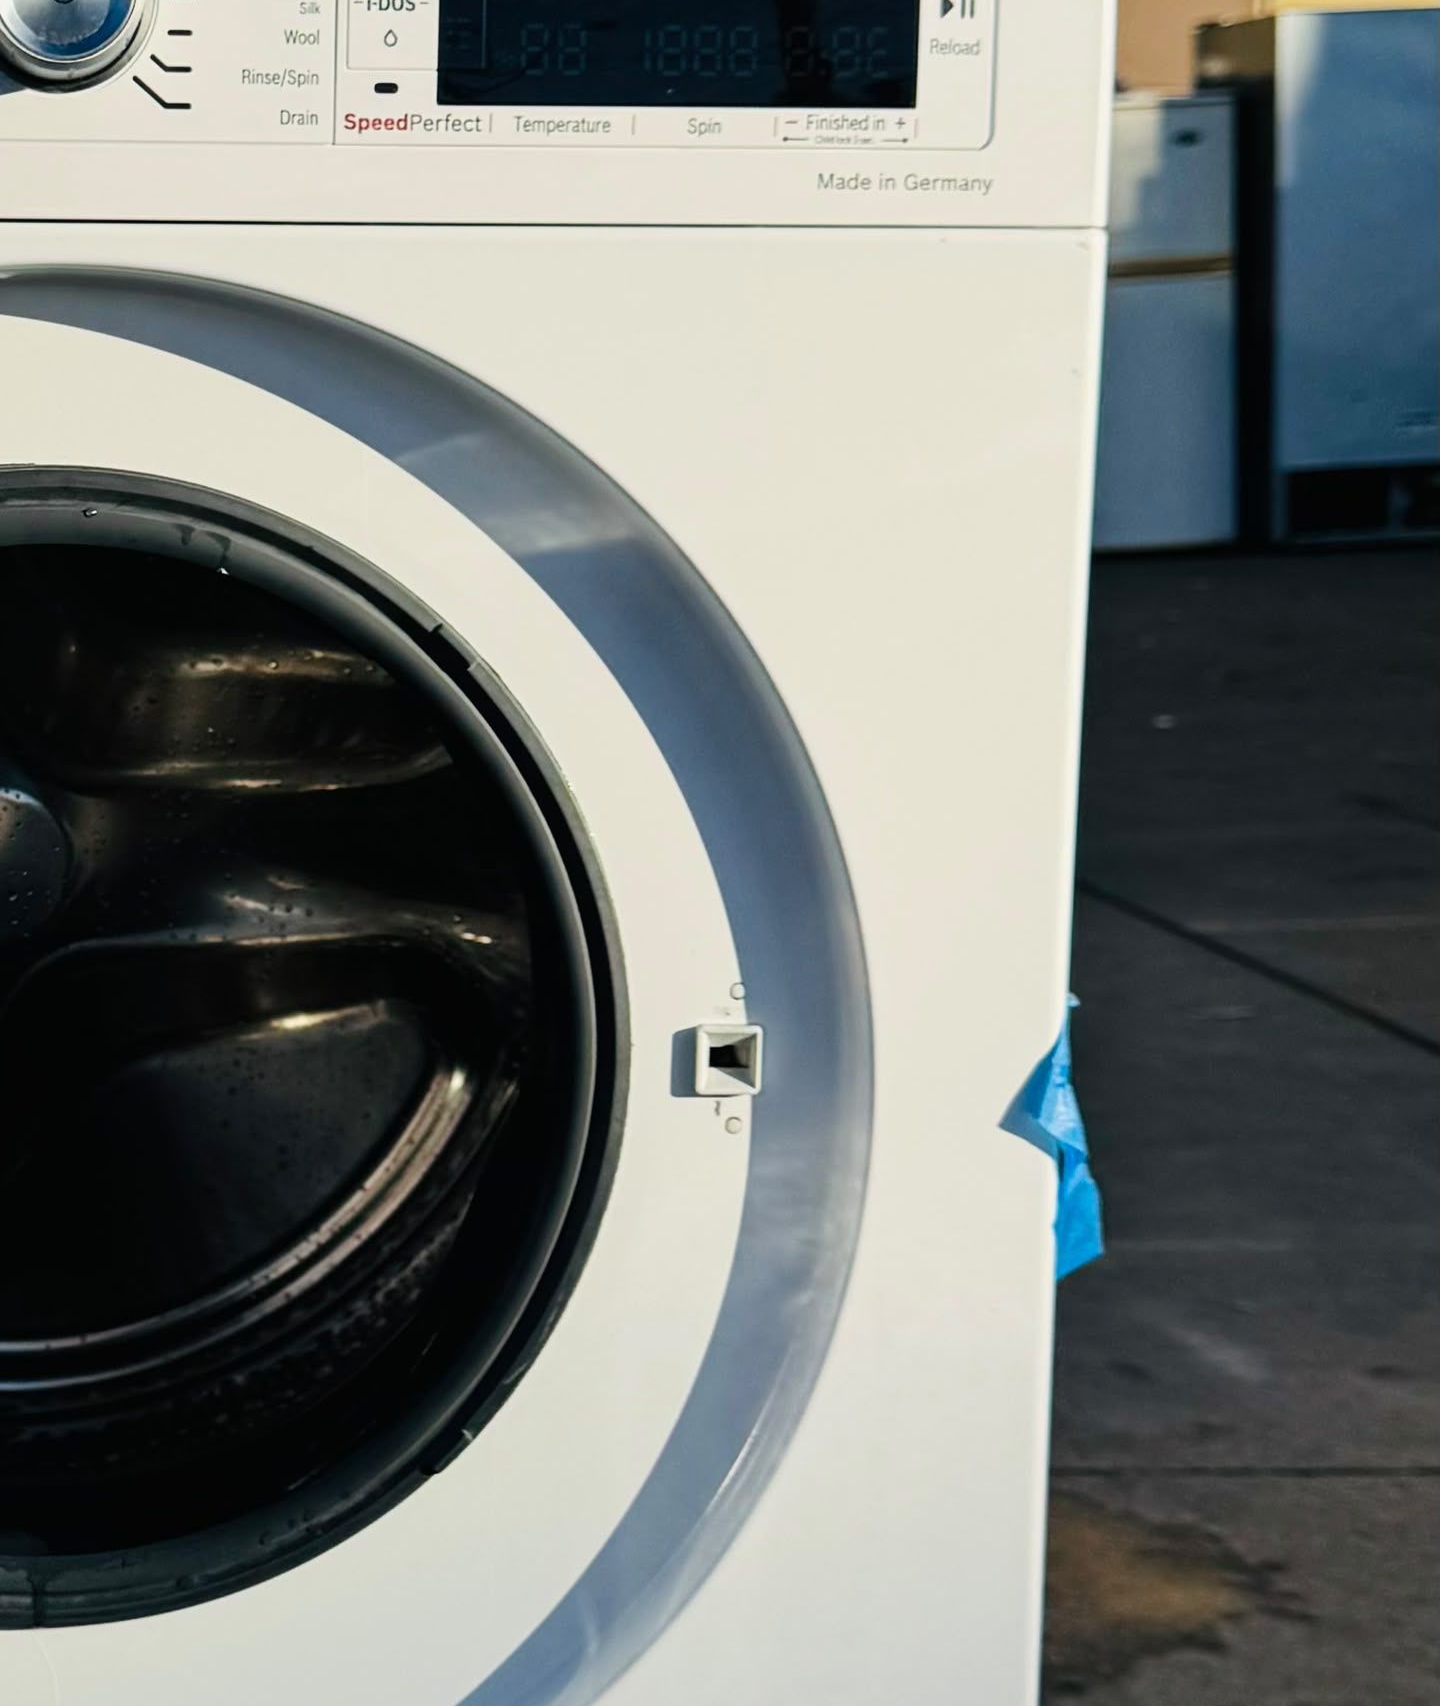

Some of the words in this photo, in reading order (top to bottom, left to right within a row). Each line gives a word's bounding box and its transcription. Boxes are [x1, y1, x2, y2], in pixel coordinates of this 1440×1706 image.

[298, 2, 321, 15] Silk
[283, 29, 321, 46] Wool
[929, 37, 981, 58] Reload
[241, 69, 320, 89] Rinse/Spin
[279, 110, 319, 127] Drain
[343, 112, 482, 135] SpeedPerfect
[513, 115, 611, 137] Temperature
[686, 116, 723, 139] Spin
[805, 114, 870, 131] Finished
[872, 114, 886, 131] in
[816, 172, 873, 191] Made
[878, 172, 896, 191] in
[903, 173, 993, 196] Germany
